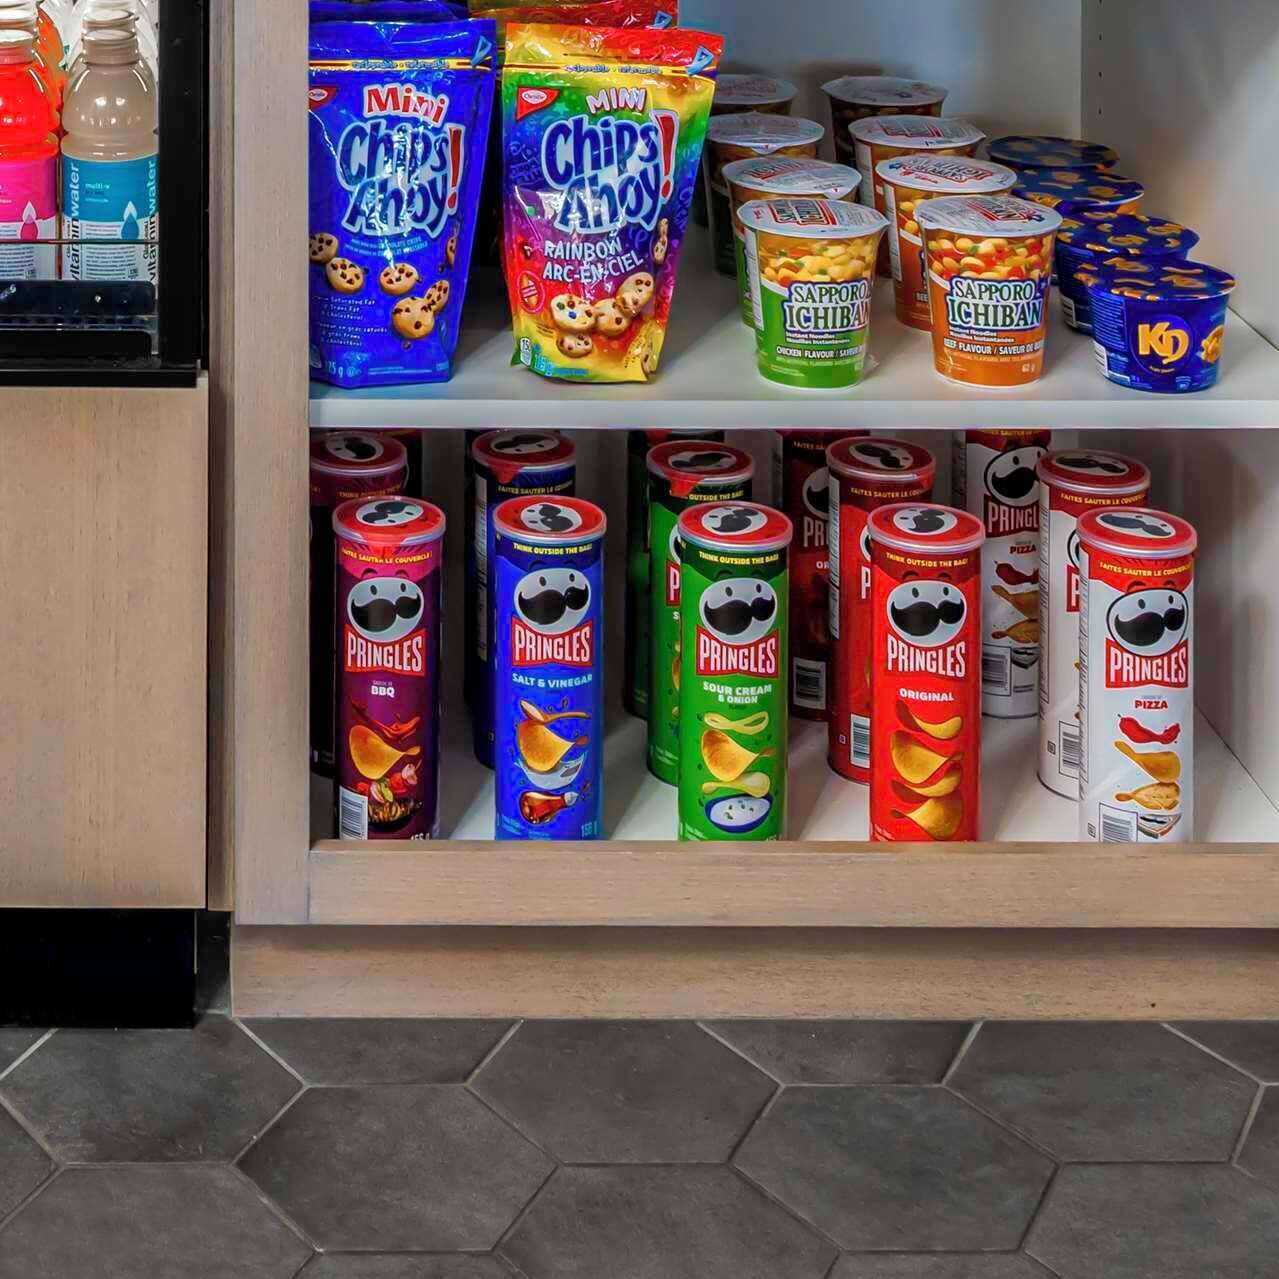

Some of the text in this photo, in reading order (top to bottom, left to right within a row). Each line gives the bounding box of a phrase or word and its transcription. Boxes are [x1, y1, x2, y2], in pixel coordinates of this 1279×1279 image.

[365, 85, 448, 124] Mini
[586, 87, 646, 114] MINI
[339, 119, 451, 190] Chips
[545, 116, 660, 189] Chips
[543, 239, 623, 261] RAINBOW
[543, 254, 645, 283] ARC-EN-CIEL
[794, 284, 868, 303] SAPPORO
[955, 282, 1034, 301] SAPPORO
[949, 298, 1042, 327] ICHIBAN
[958, 342, 992, 355] FLAVOUR
[999, 345, 1026, 354] SAVEUR
[1138, 323, 1189, 365] KD
[804, 349, 834, 358] FLAVOUR
[689, 492, 730, 501] OUTSIDE THE
[533, 545, 564, 555] OUTSIDE
[565, 545, 577, 554] THE
[1009, 544, 1037, 554] PIZZA
[384, 556, 393, 564] LE
[720, 555, 751, 564] OUTSIDE
[752, 555, 763, 564] THE
[907, 556, 937, 567] OUTSIDE
[938, 559, 951, 567] THE
[1123, 566, 1152, 577] SAUTER
[1154, 568, 1162, 576] LE
[347, 636, 423, 673] PRINGLES
[514, 628, 591, 665] PRINGLES
[887, 632, 966, 678] PRINGLES
[698, 637, 776, 674] PRINGLES
[1109, 646, 1187, 686] PRINGLES
[512, 673, 593, 688] SALT & VINEGAR
[371, 684, 395, 699] BBQ
[703, 682, 772, 697] SOUR CREAM
[899, 688, 954, 702] ORIGINAL
[728, 695, 758, 704] ONION
[1134, 699, 1168, 710] PIZZA
